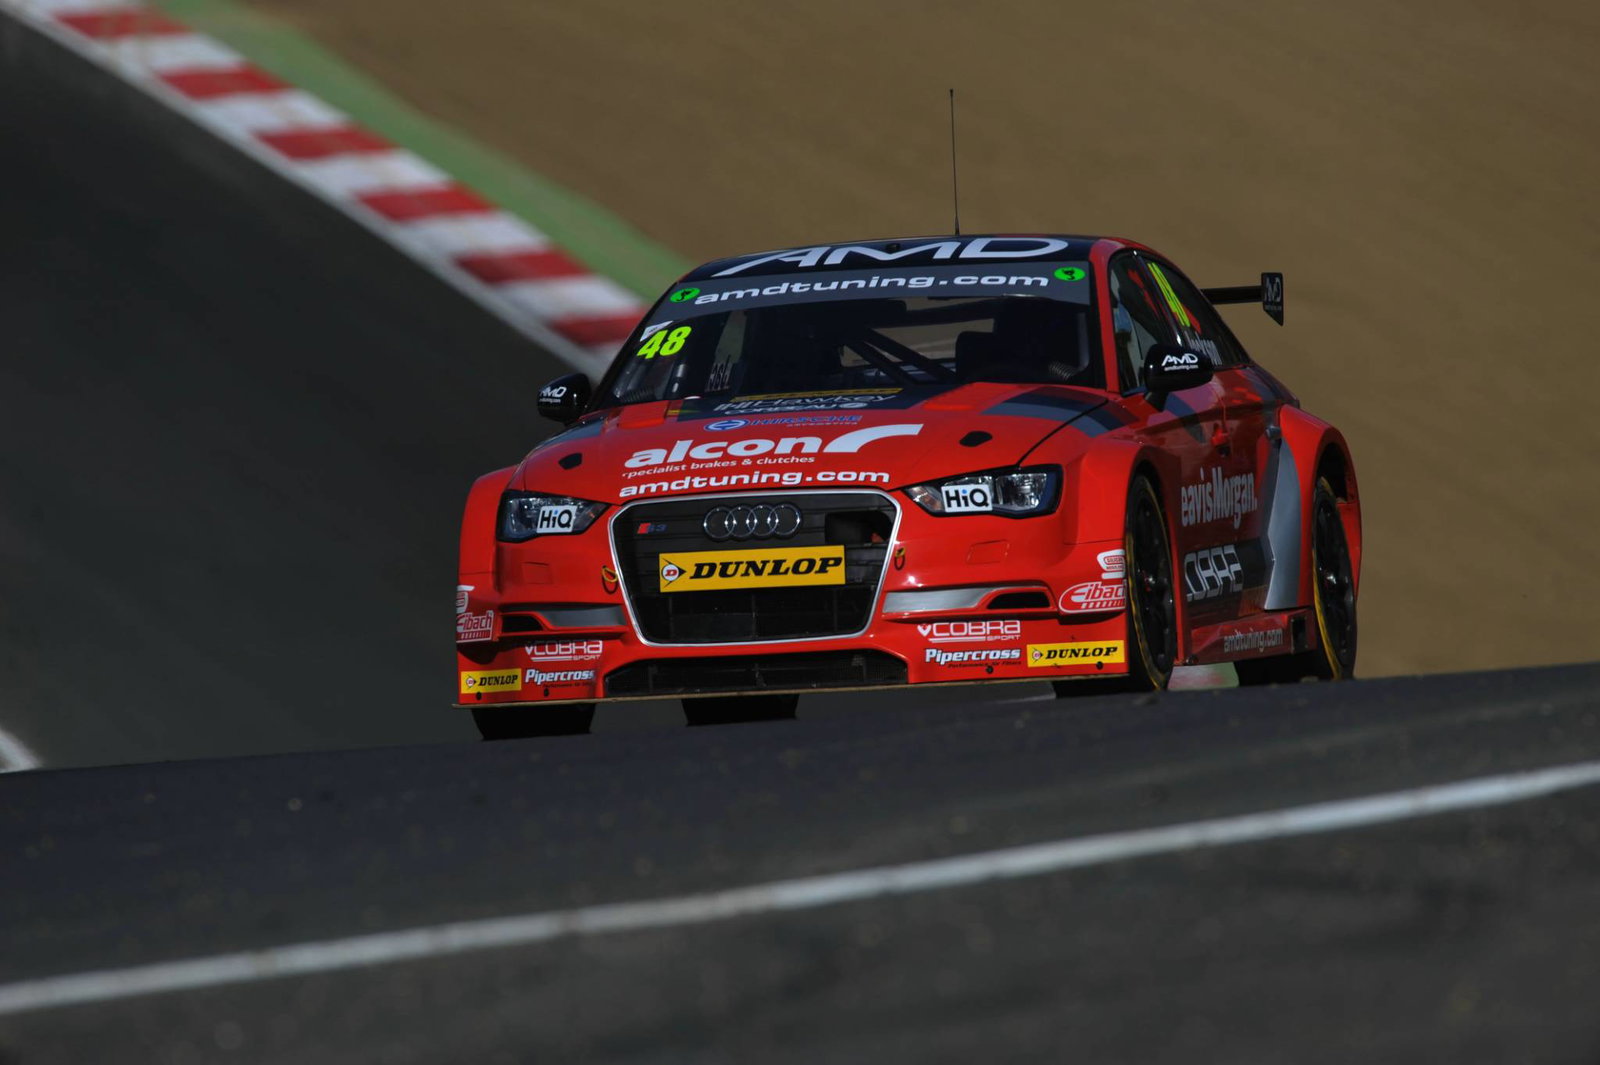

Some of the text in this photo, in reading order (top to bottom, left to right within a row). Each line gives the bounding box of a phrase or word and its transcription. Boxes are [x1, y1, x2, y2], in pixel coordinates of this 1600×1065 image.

[710, 237, 1069, 278] AMD
[694, 274, 1050, 305] amdtuning.com
[636, 326, 693, 359] 48
[1161, 353, 1199, 367] AMD
[623, 436, 823, 469] alcon
[690, 460, 737, 470] brakes
[741, 458, 752, 466] &
[756, 456, 816, 465] clutches
[618, 470, 891, 498] amdtuning.com
[945, 488, 990, 509] HiQ
[539, 509, 572, 529] HiQ
[689, 557, 843, 580] DUNLOP
[925, 648, 1021, 666] Pipercross
[1045, 646, 1118, 659] DUNLOP
[478, 674, 519, 687] DUNLOP
